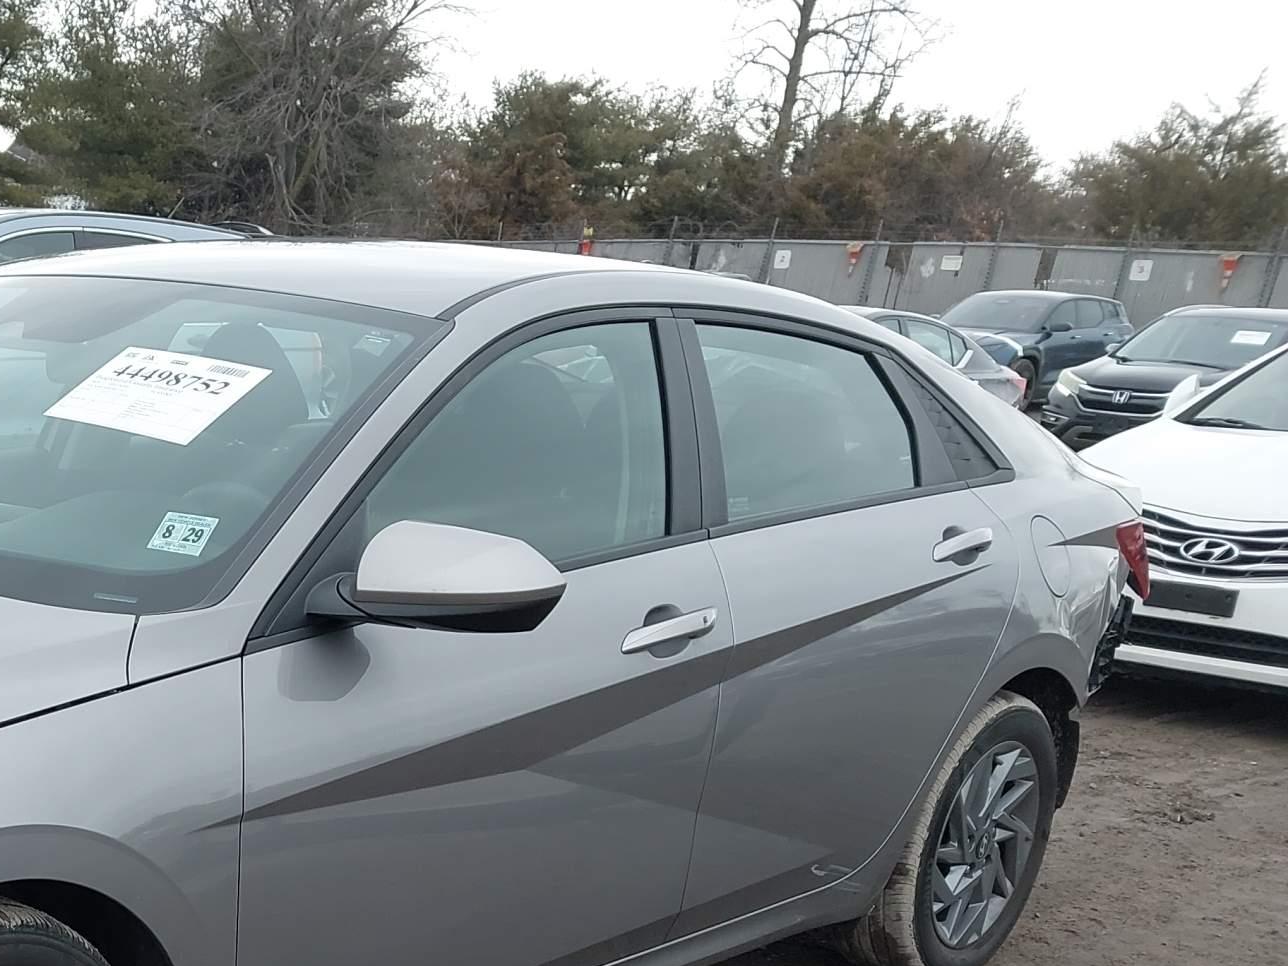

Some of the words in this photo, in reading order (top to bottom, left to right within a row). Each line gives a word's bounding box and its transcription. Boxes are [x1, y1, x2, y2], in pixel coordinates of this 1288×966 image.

[113, 364, 231, 395] 44498752
[162, 524, 175, 539] 8
[182, 527, 205, 543] 29
